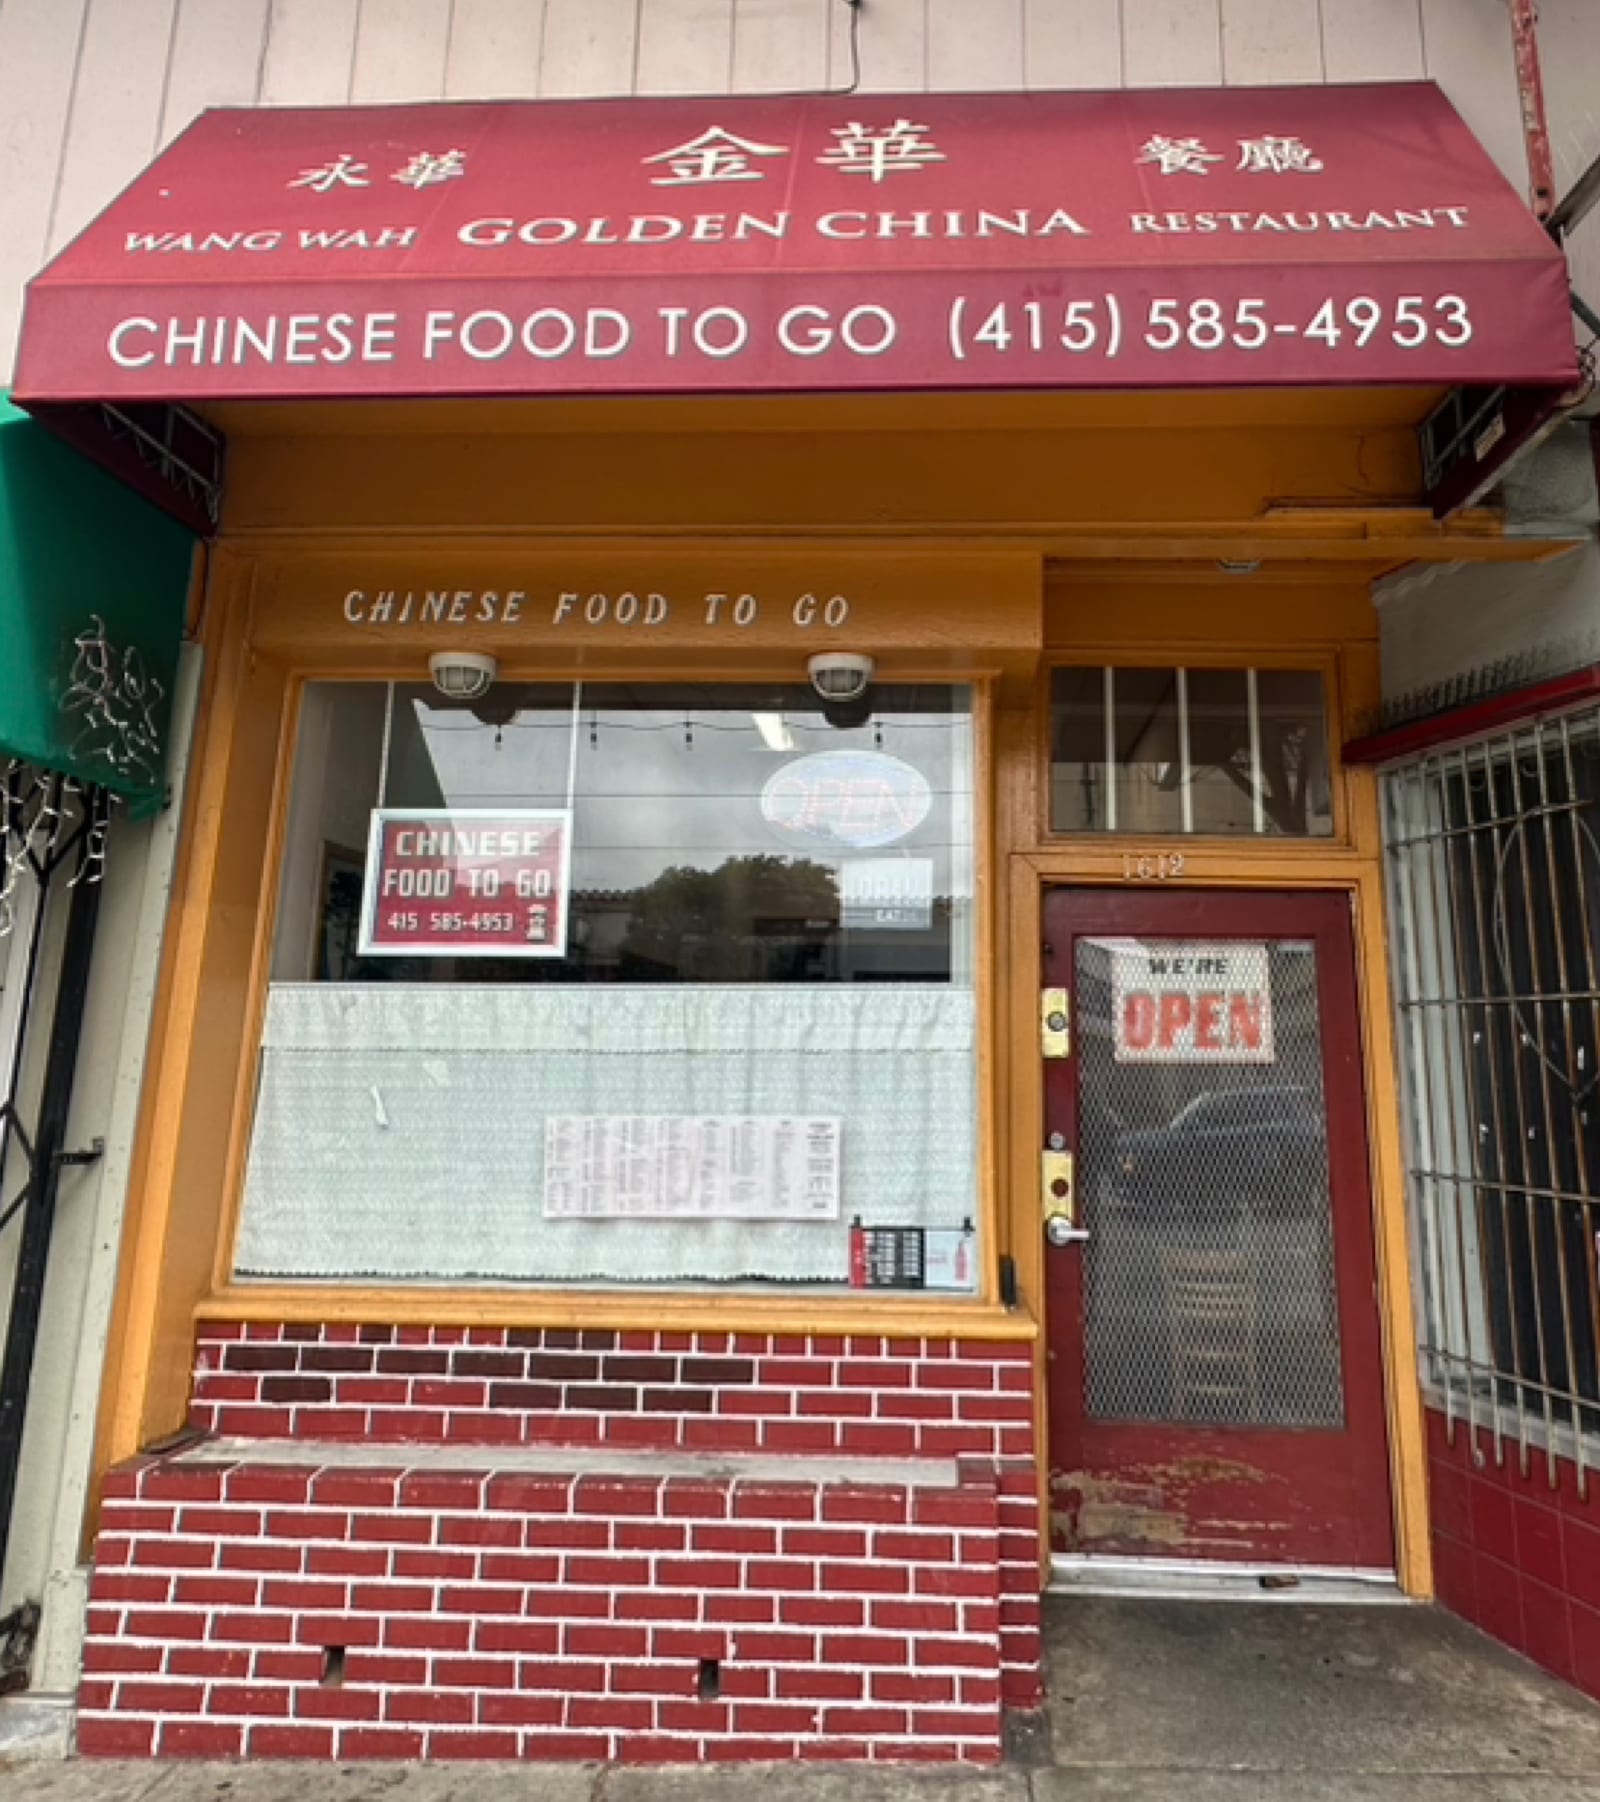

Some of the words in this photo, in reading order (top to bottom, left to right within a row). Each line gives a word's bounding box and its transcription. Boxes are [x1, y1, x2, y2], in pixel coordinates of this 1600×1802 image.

[640, 119, 946, 184] 金華
[123, 231, 283, 252] WANG
[298, 227, 416, 249] WAH
[457, 212, 790, 246] GOLDEN
[815, 208, 1088, 239] CHINA
[1130, 206, 1470, 235] RESTAURANT
[107, 312, 397, 368] CHINESE
[423, 308, 630, 360] FOOD
[658, 307, 748, 356] TO
[777, 304, 897, 355] GO
[949, 294, 1122, 359] (415)
[1144, 295, 1473, 349] 585-4953
[343, 591, 526, 623] CHINESE
[552, 593, 668, 626] FOOD
[704, 594, 757, 626] TO
[792, 596, 849, 627] GO
[395, 831, 541, 857] CHINESE
[382, 868, 451, 898] FOOD
[468, 868, 500, 898] TO
[516, 868, 551, 898] GO
[1123, 853, 1185, 880] 1612
[387, 912, 418, 931] 415
[1123, 991, 1261, 1051] OPEN
